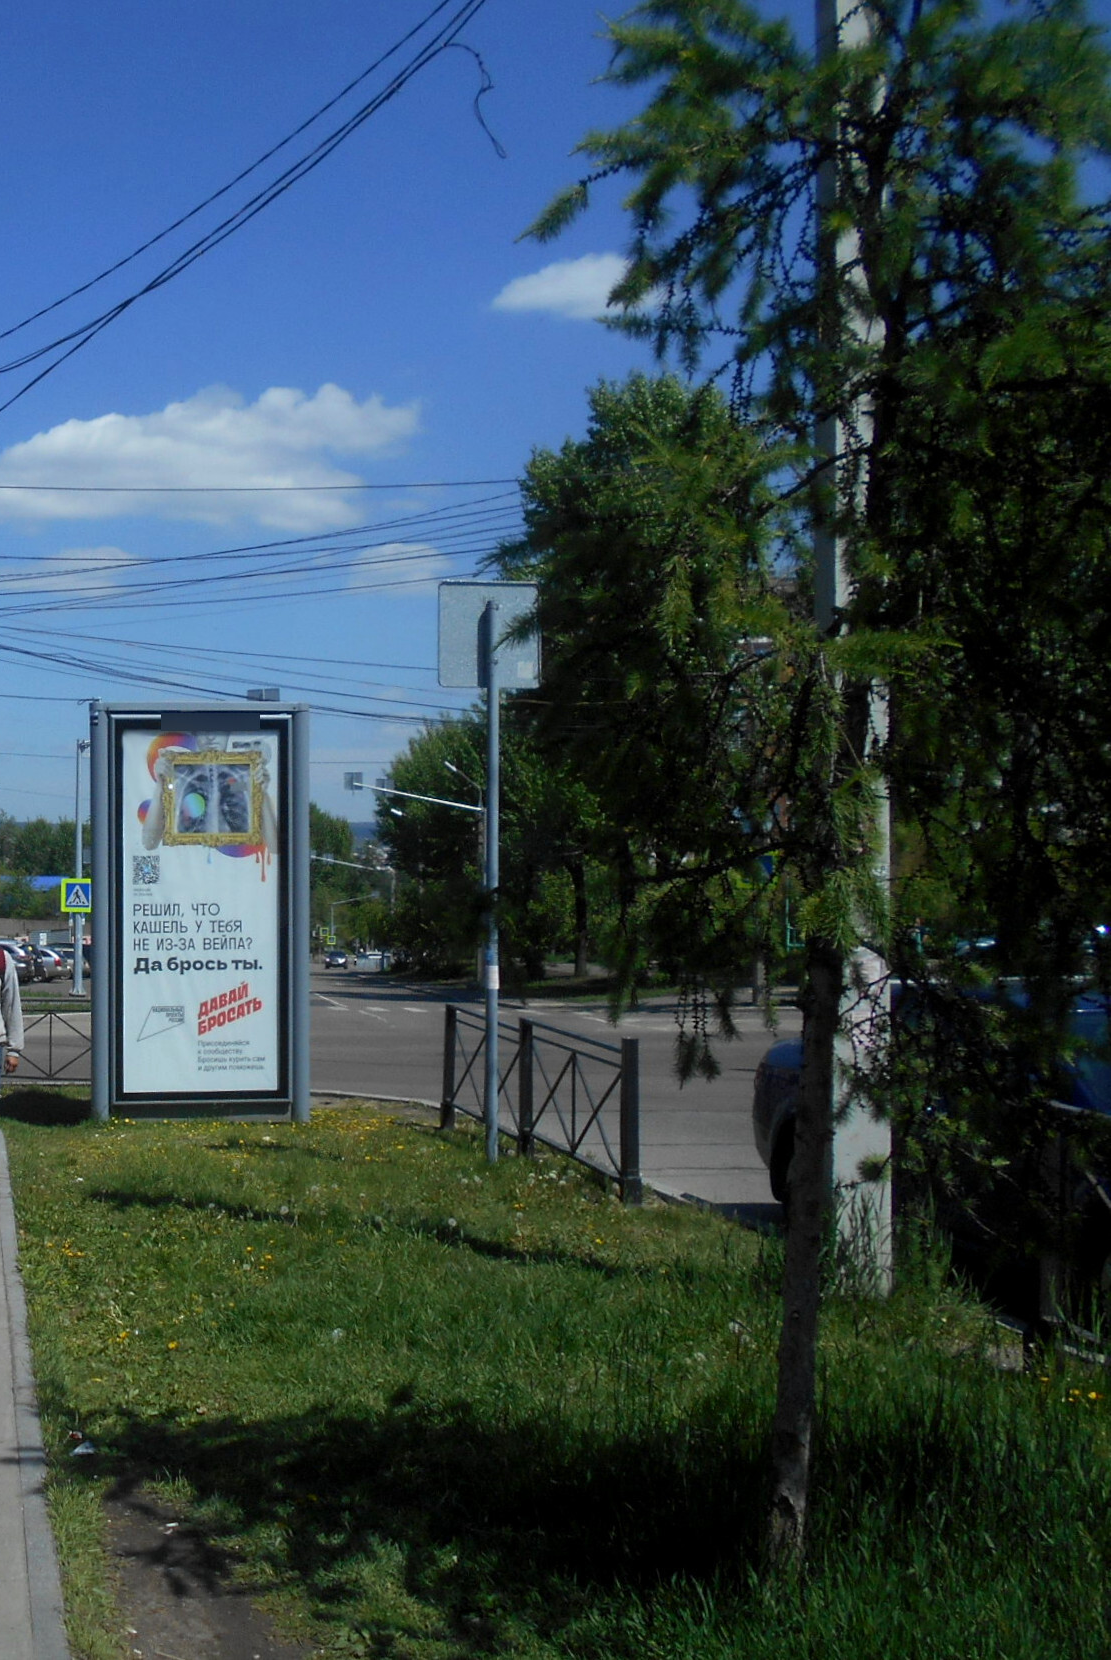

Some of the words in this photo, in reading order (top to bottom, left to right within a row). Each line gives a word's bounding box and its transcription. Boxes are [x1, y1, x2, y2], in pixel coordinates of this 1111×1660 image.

[133, 903, 185, 917] РЕШИЛ,
[191, 903, 220, 916] ЧТО
[133, 921, 188, 934] КАШЕЛЬ
[195, 921, 202, 933] У
[133, 938, 149, 951] НЕ
[157, 938, 195, 951] ИЗ-ЗА
[203, 934, 253, 950] ВЕЙПА?
[134, 958, 162, 974] Да
[167, 957, 227, 975] брось
[231, 959, 263, 970] ты.
[198, 981, 249, 1020] ДАВАЙ
[197, 997, 262, 1036] БРОСАТЬ
